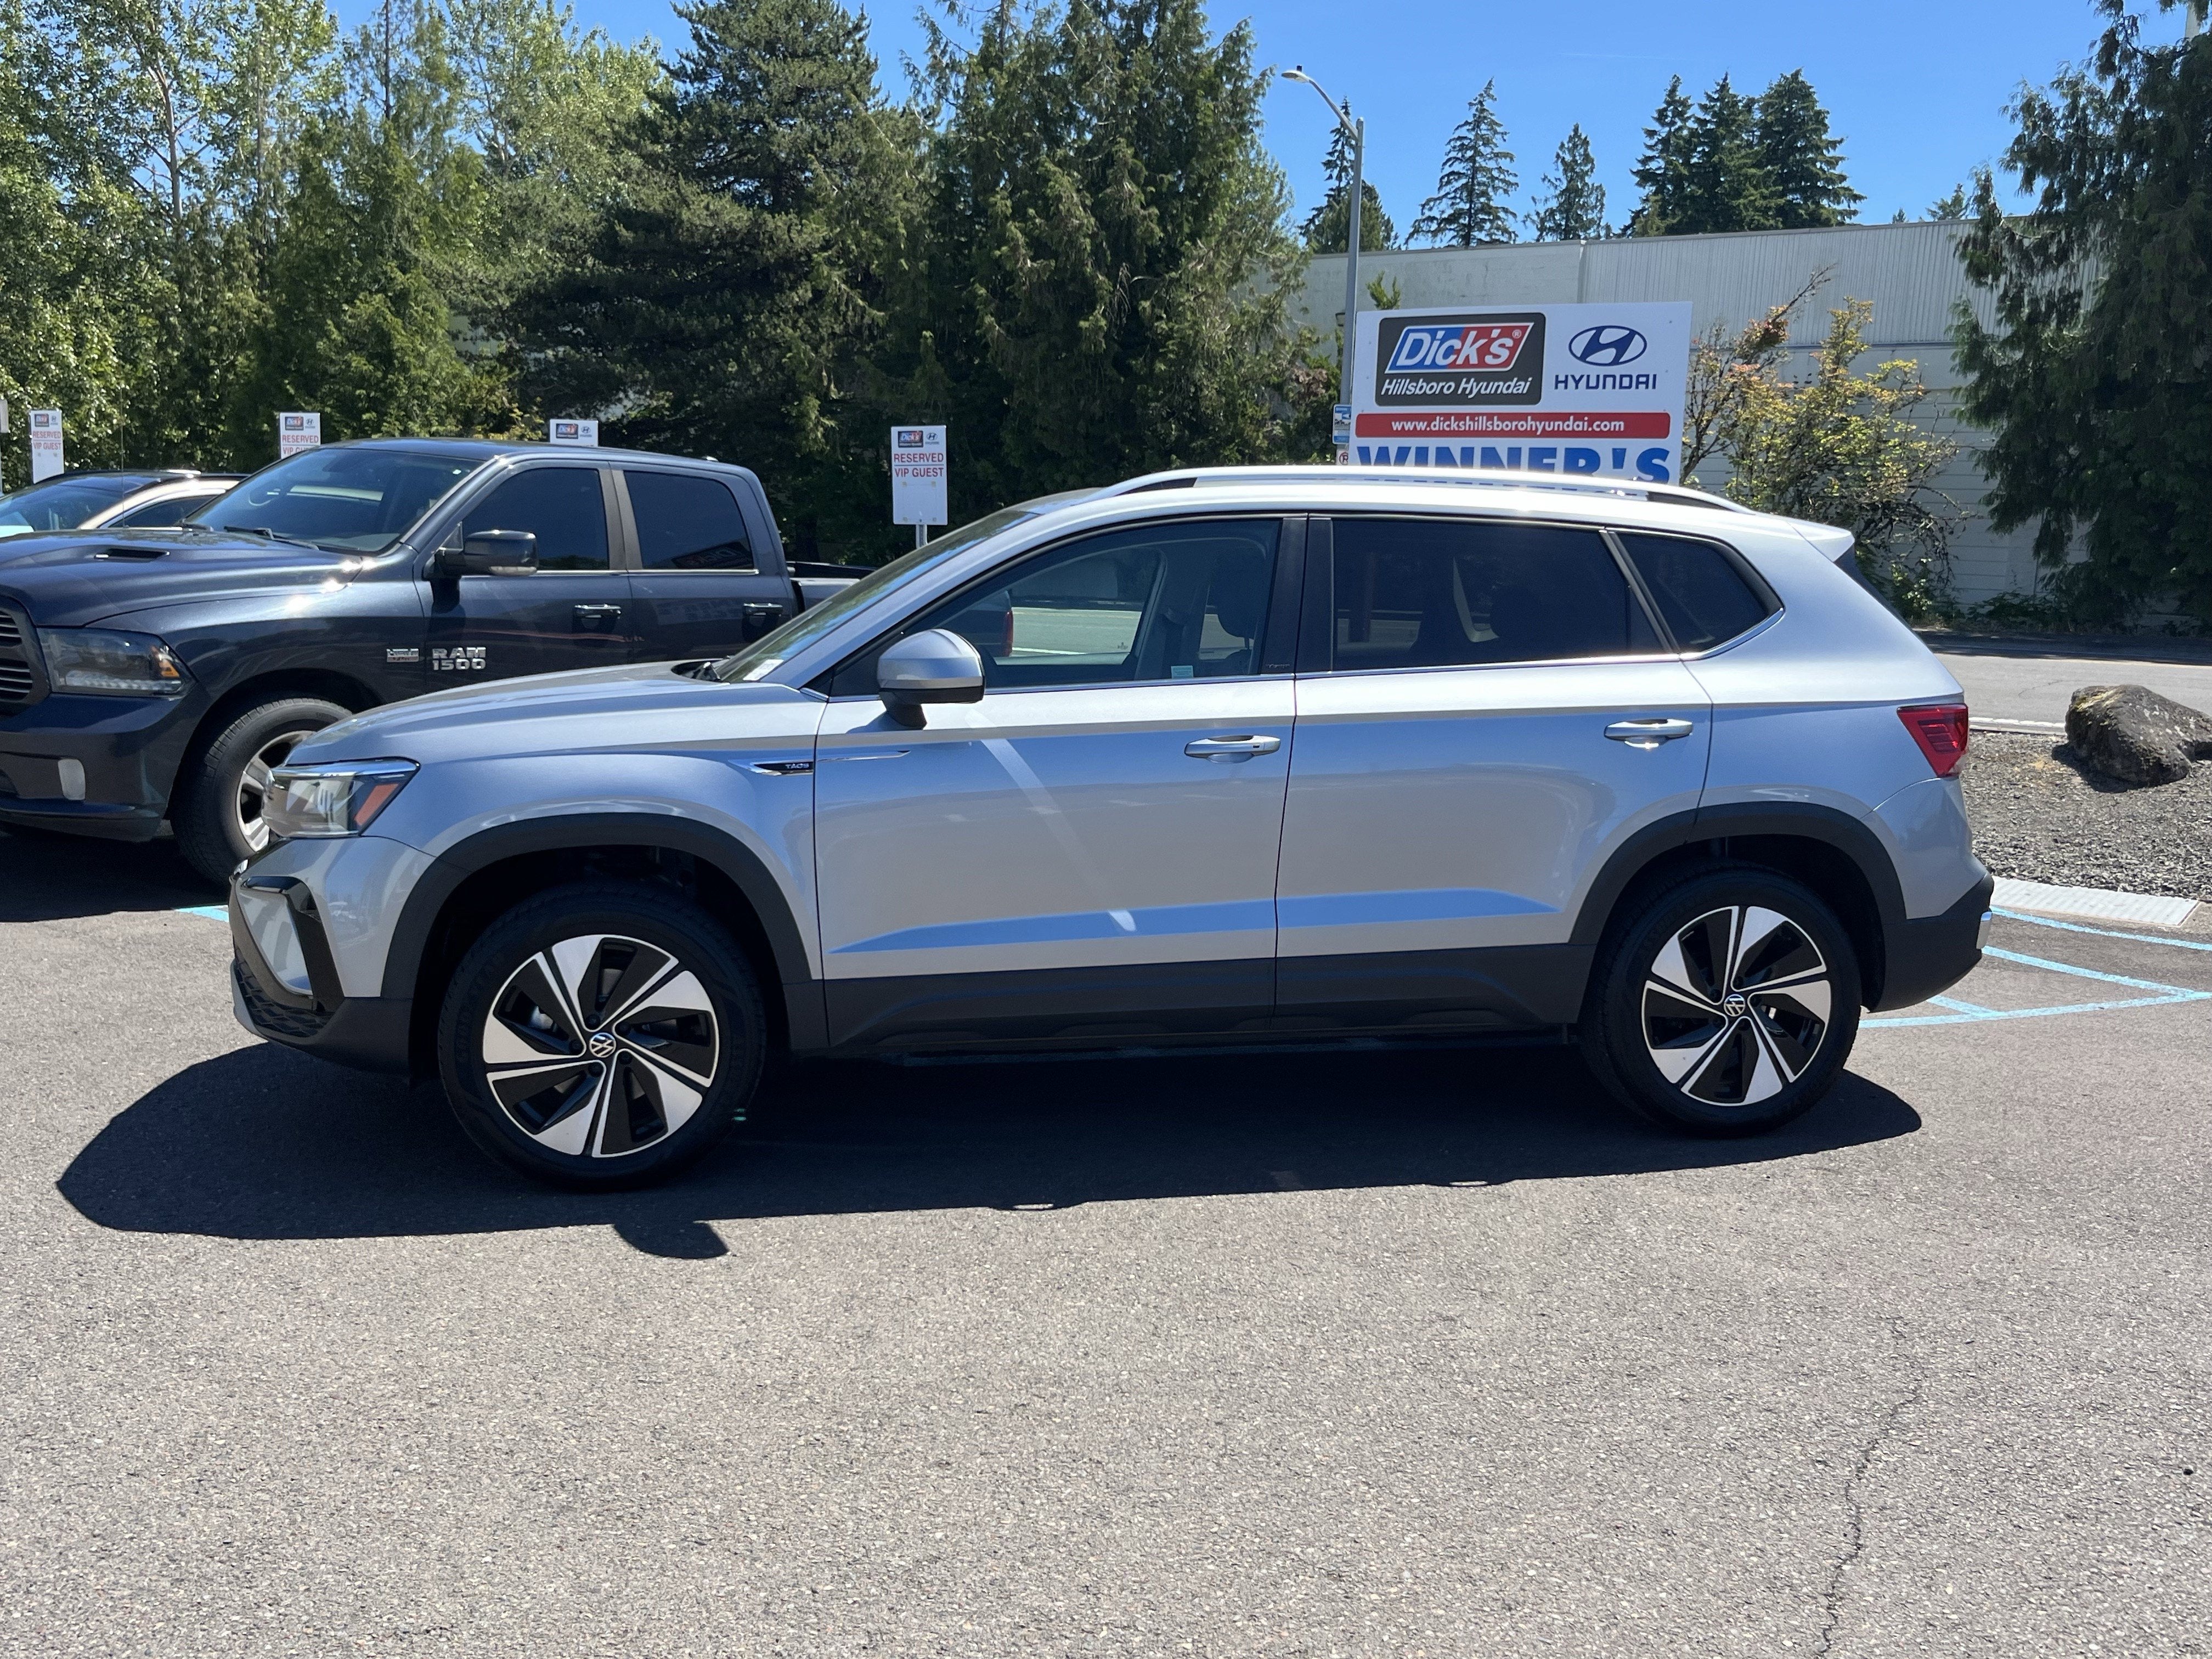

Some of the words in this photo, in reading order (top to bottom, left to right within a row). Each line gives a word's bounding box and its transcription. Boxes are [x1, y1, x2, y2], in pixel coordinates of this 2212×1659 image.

[1396, 329, 1514, 366] Dick's
[1381, 377, 1455, 396] Hillsboro
[1457, 377, 1532, 398] Hyundai
[1554, 374, 1657, 390] HYUNDAI
[1391, 416, 1624, 435] www.dickshillsborohyundai.com
[33, 430, 61, 438] RESERVED
[282, 435, 319, 443] RESERVED
[894, 453, 944, 462] RESERVED
[895, 467, 909, 477] VIP
[912, 467, 944, 477] GUEST
[432, 646, 486, 659] RAM
[432, 658, 486, 670] 1500
